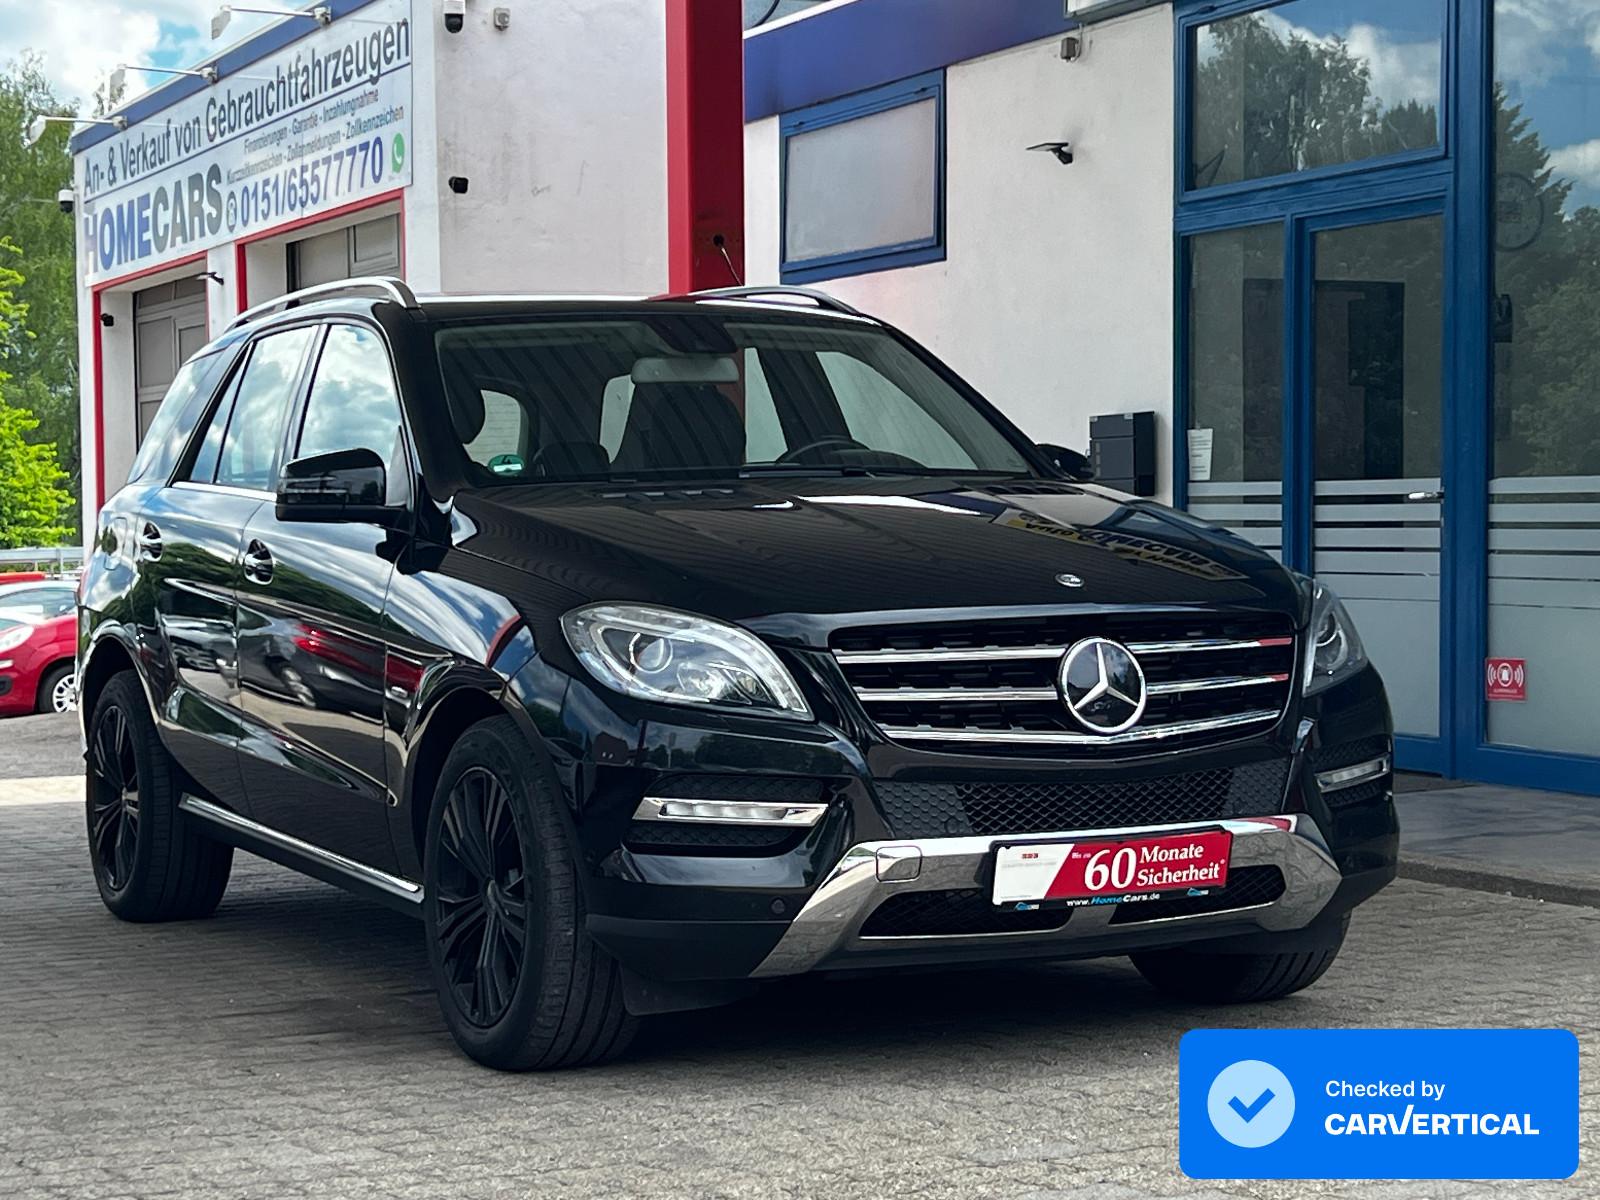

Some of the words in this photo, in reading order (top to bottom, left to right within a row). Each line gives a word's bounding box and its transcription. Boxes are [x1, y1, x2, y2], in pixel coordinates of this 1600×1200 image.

[84, 159, 104, 197] An-
[107, 150, 118, 185] &
[119, 119, 171, 181] Verkauf
[174, 116, 200, 151] von
[206, 17, 409, 142] Gebrauchtfahrzeugen
[84, 163, 222, 273] HOMECARS
[242, 136, 383, 228] 0151/65577770
[1085, 848, 1137, 890] 60
[1139, 844, 1204, 863] Monate
